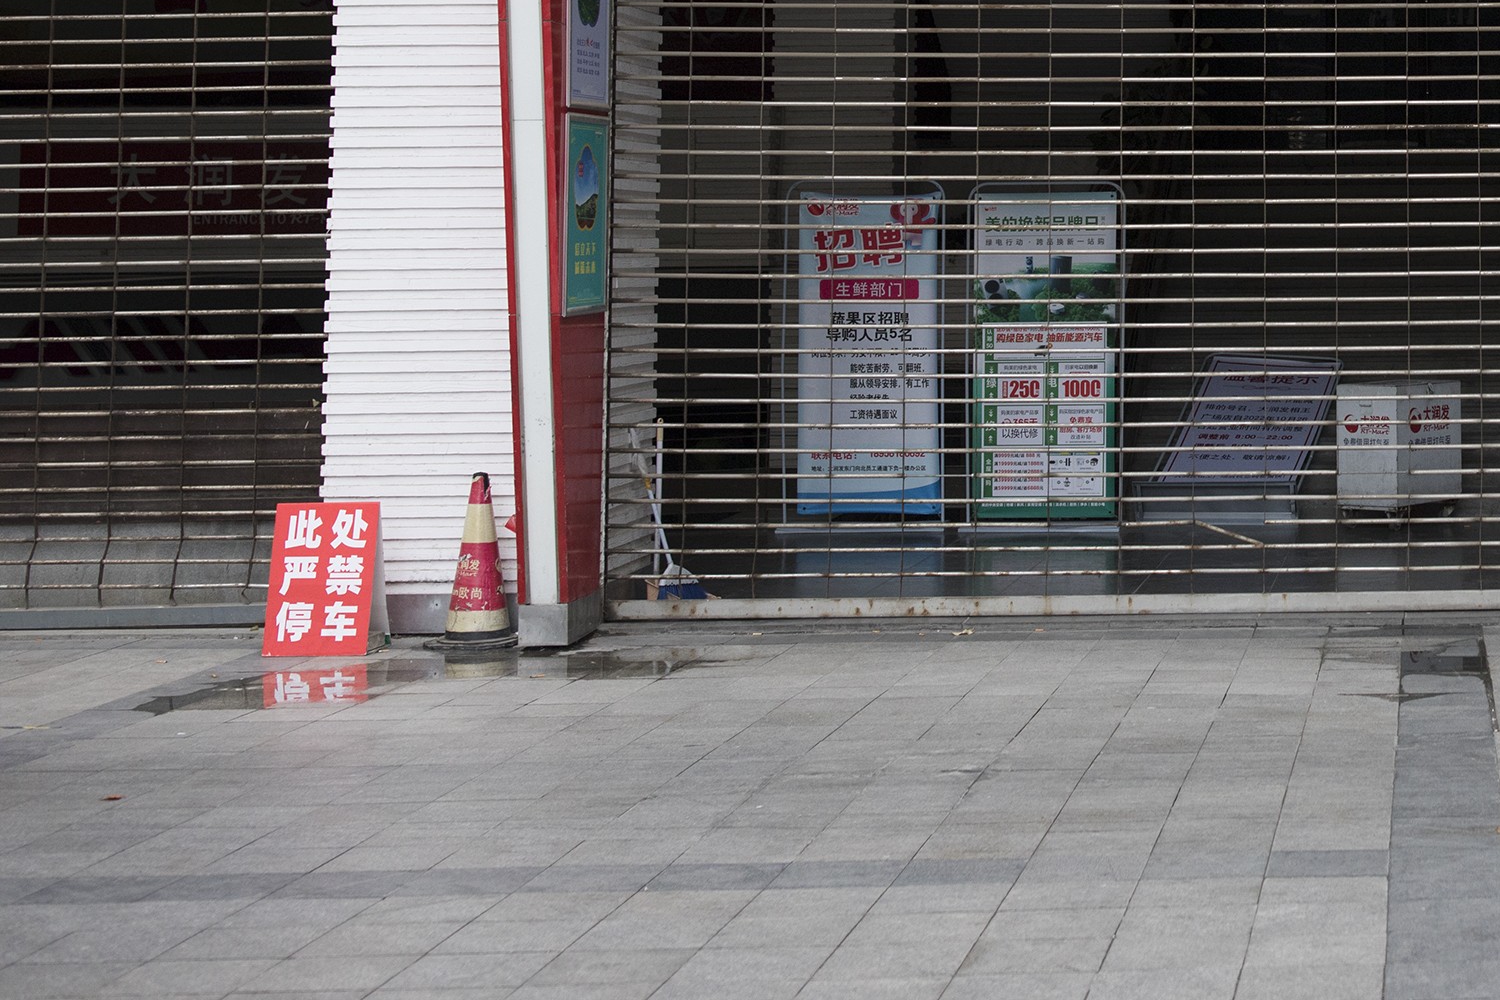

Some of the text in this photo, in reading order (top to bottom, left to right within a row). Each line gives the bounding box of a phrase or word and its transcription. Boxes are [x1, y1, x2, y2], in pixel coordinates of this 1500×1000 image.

[107, 153, 308, 206] 大润发
[985, 215, 1098, 232] 美的换新品牌日
[814, 223, 904, 271] 招聘
[836, 282, 902, 297] 生鲜部门
[831, 311, 909, 325] 蔬果区招聘
[826, 327, 912, 342] 导购人员5名
[1424, 405, 1450, 420] 大润发
[1001, 428, 1038, 439] 以换代修
[285, 508, 369, 550] 此处
[279, 555, 365, 596] 严禁
[275, 601, 359, 642] 停车
